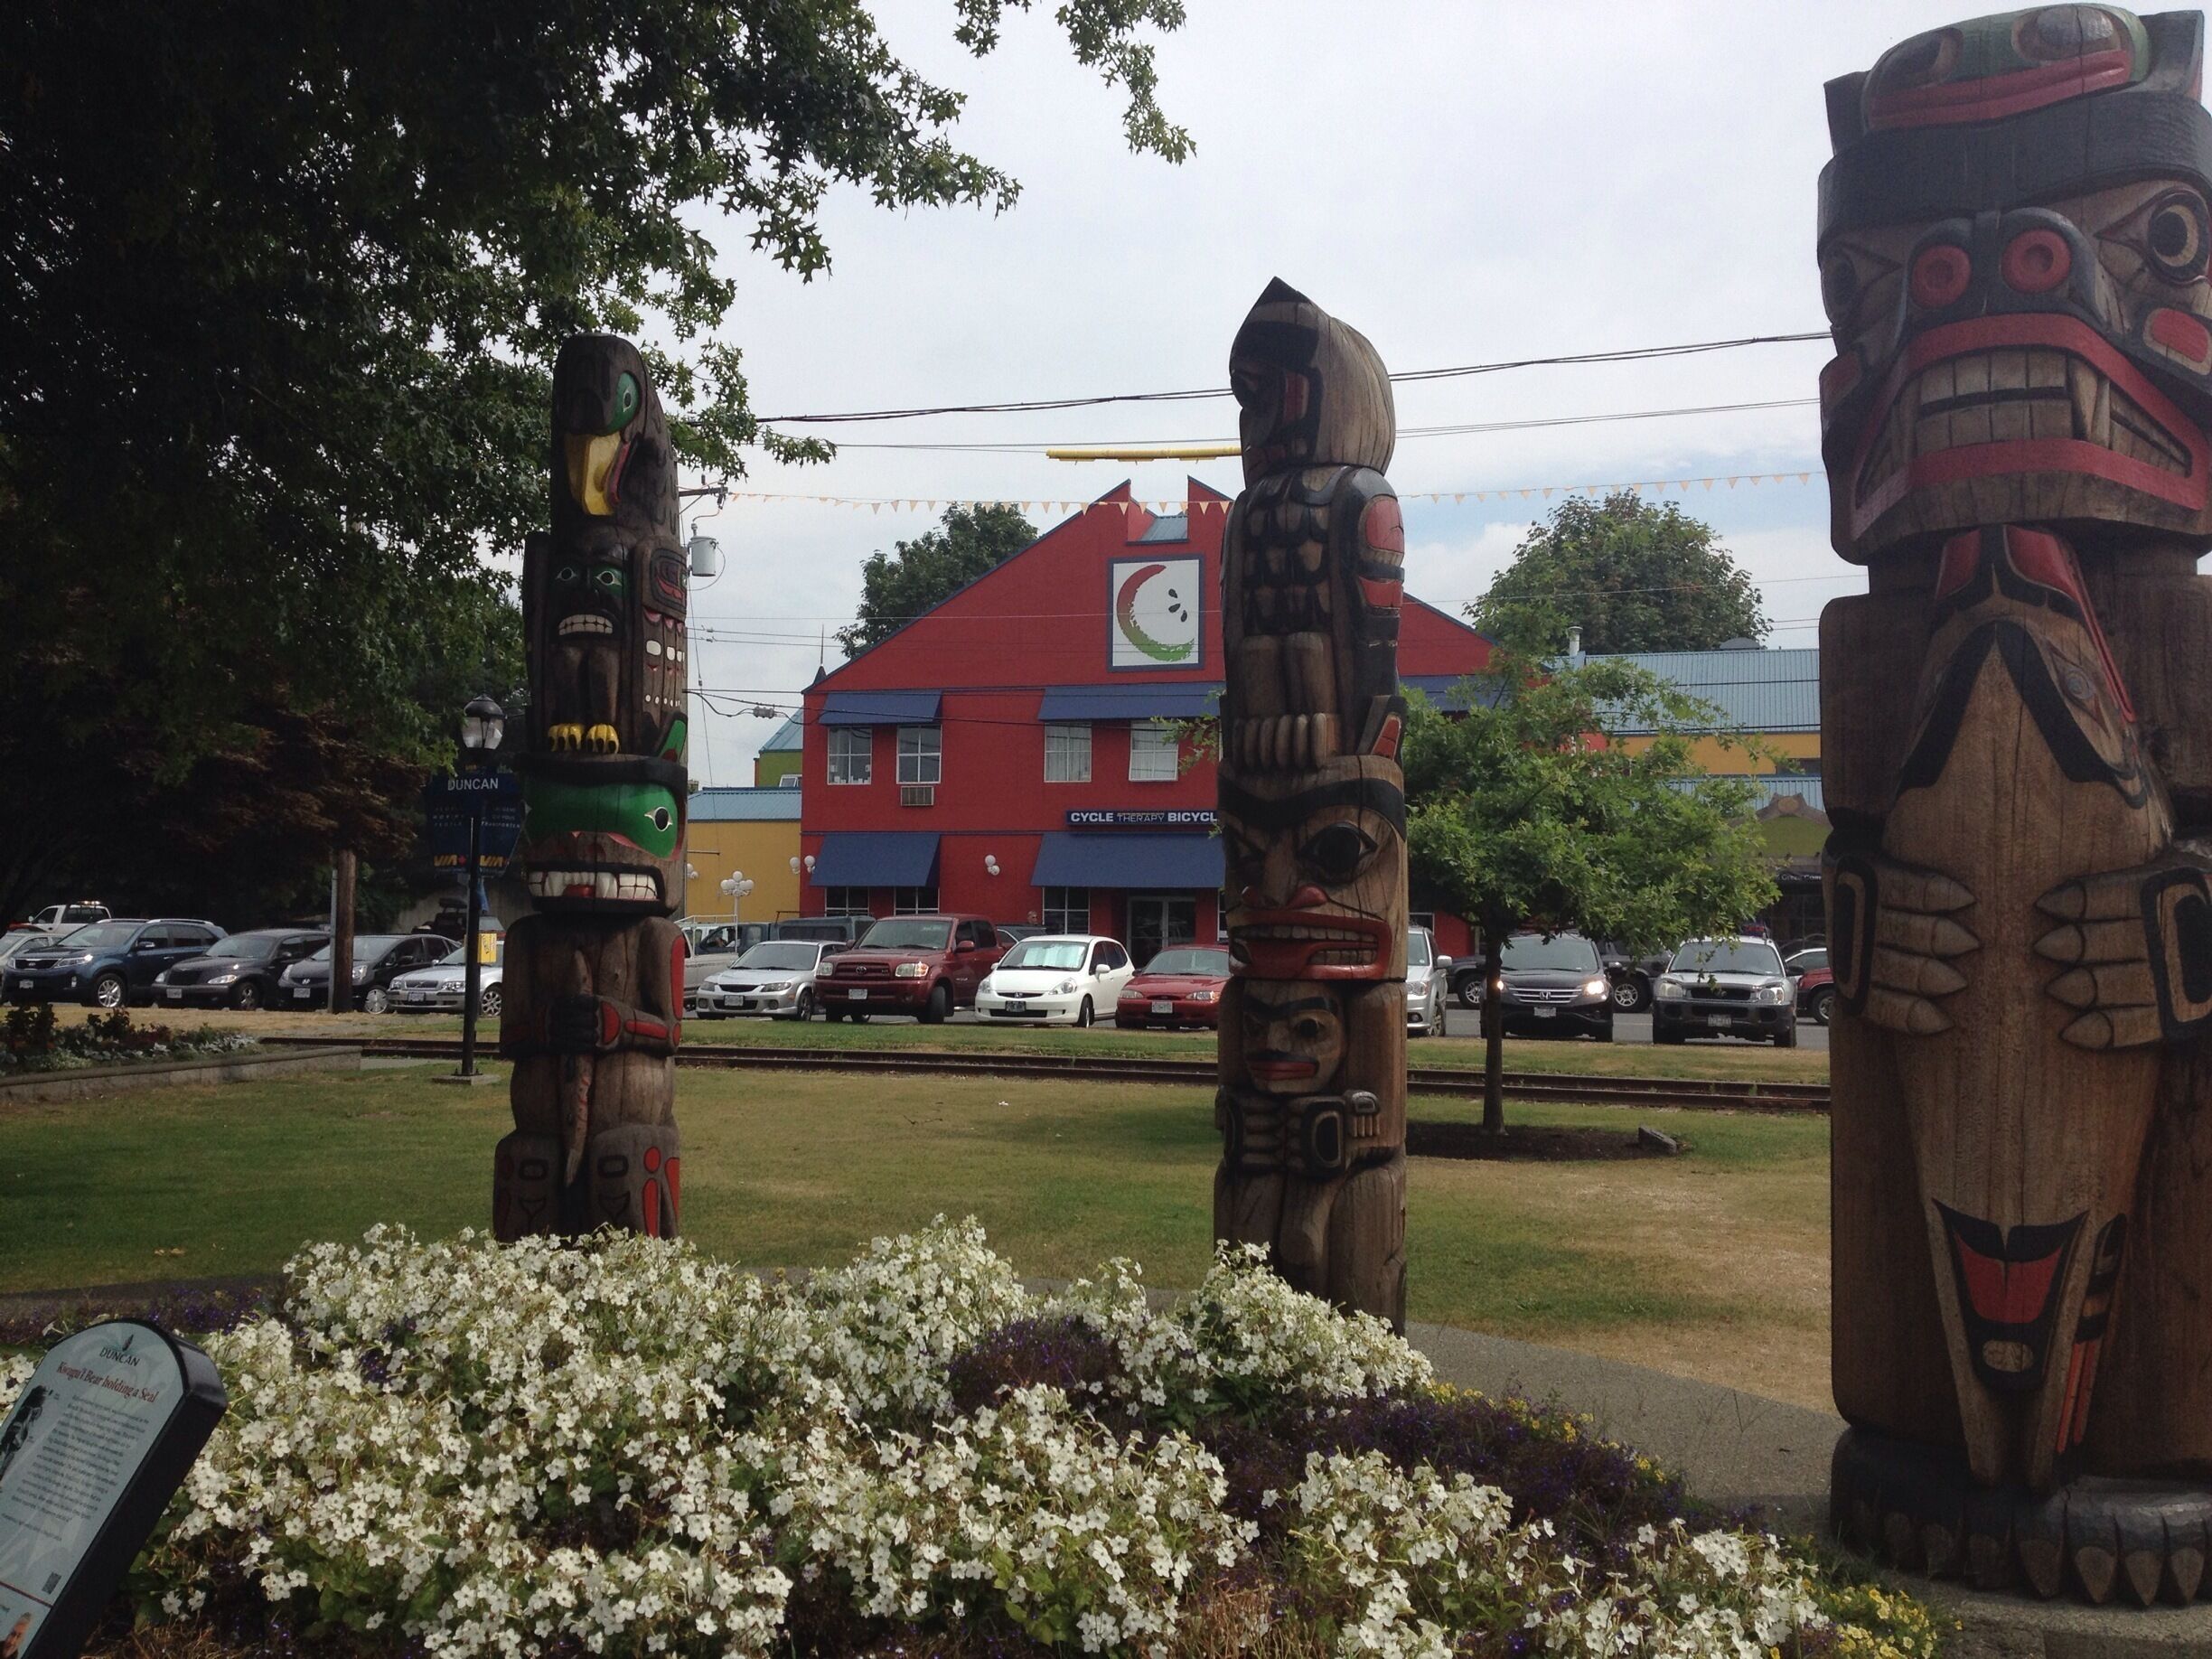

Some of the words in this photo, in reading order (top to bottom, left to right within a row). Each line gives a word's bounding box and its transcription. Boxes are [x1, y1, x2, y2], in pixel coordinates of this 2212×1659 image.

[448, 778, 499, 791] DUNCAN
[1071, 812, 1113, 822] CYCLE
[1117, 813, 1166, 822] THERAPY
[434, 855, 457, 867] VIA
[480, 855, 502, 867] VIA
[99, 1347, 140, 1366] DUNCAN
[84, 1370, 103, 1383] Bear
[102, 1375, 134, 1397] holding
[132, 1388, 139, 1397] a
[141, 1388, 159, 1402] Seal
